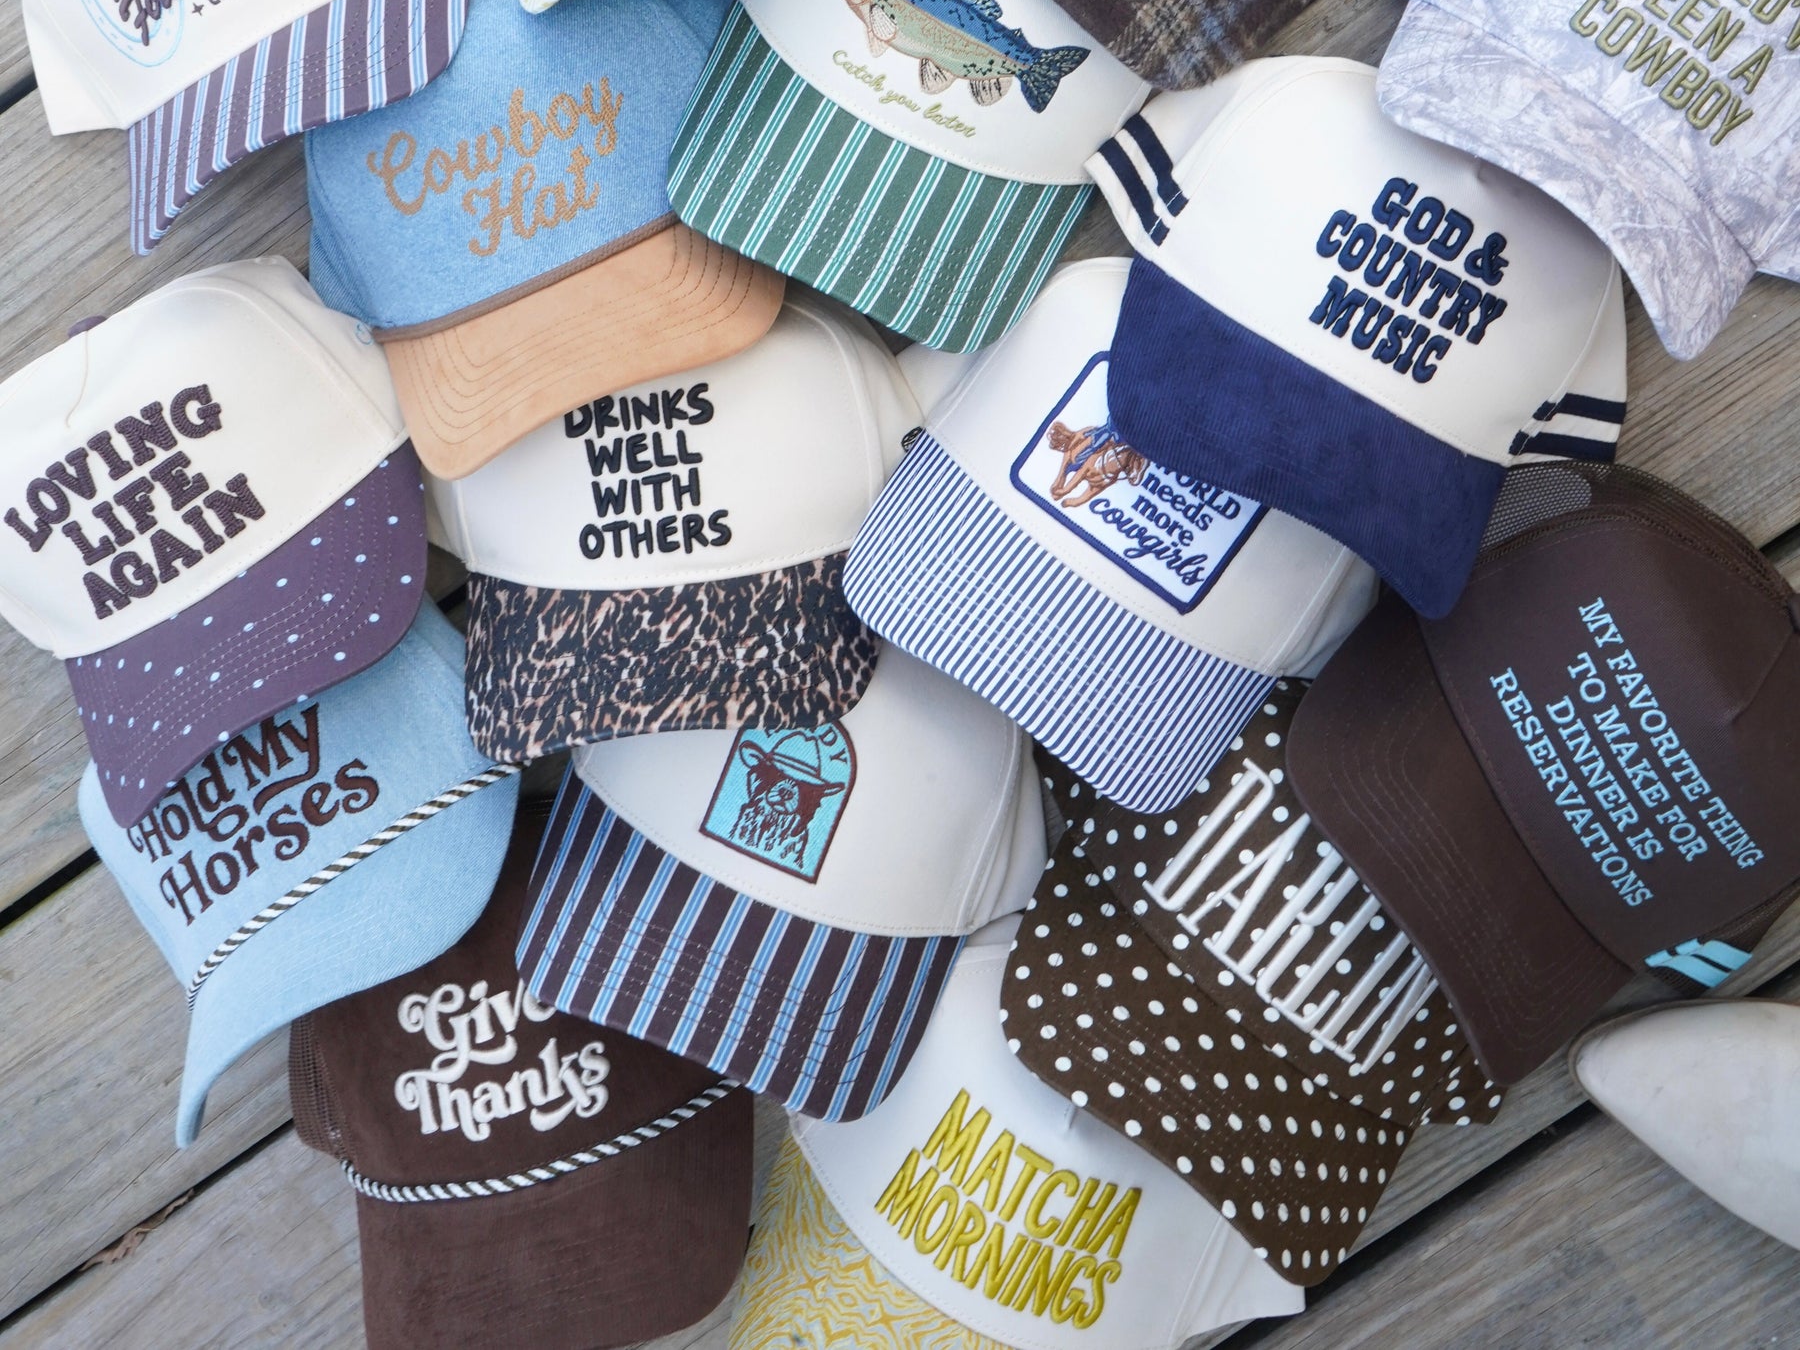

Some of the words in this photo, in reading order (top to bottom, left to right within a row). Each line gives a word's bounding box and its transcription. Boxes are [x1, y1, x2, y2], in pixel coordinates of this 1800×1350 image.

[833, 50, 886, 92] Catch
[879, 90, 920, 112] you
[923, 102, 976, 138] later
[1728, 44, 1774, 95] A
[366, 76, 624, 216] Cowboy
[462, 144, 600, 257] Hat
[1316, 209, 1507, 345] COUNTRY
[1372, 177, 1474, 262] GOD
[1464, 232, 1509, 286] &
[1309, 275, 1452, 383] MUSIC
[564, 383, 714, 438] DRINKS
[585, 430, 702, 476] WELL
[4, 384, 222, 552] LOVING
[62, 451, 210, 566] LIFE
[591, 467, 701, 518] WITH
[1131, 494, 1194, 547] more
[1141, 473, 1213, 531] needs
[83, 472, 266, 620] AGAIN
[579, 509, 732, 559] OTHERS
[1089, 498, 1209, 586] cowgirls
[127, 751, 250, 863] Hold
[221, 702, 320, 815] My
[1490, 667, 1655, 907] RESERVATIONS
[1546, 695, 1640, 833] DINNER
[1626, 828, 1664, 860] IS
[1568, 652, 1606, 704] TO
[1593, 705, 1671, 808] MAKE
[1656, 805, 1708, 862] FOR
[1578, 597, 1624, 648] MY
[1606, 649, 1711, 802] FAVORITE
[1700, 796, 1765, 869] THING
[160, 758, 379, 926] Horses
[395, 1037, 610, 1142] Thanks
[922, 1088, 1142, 1259] MATCHA
[874, 1147, 1122, 1330] MORNINGS
